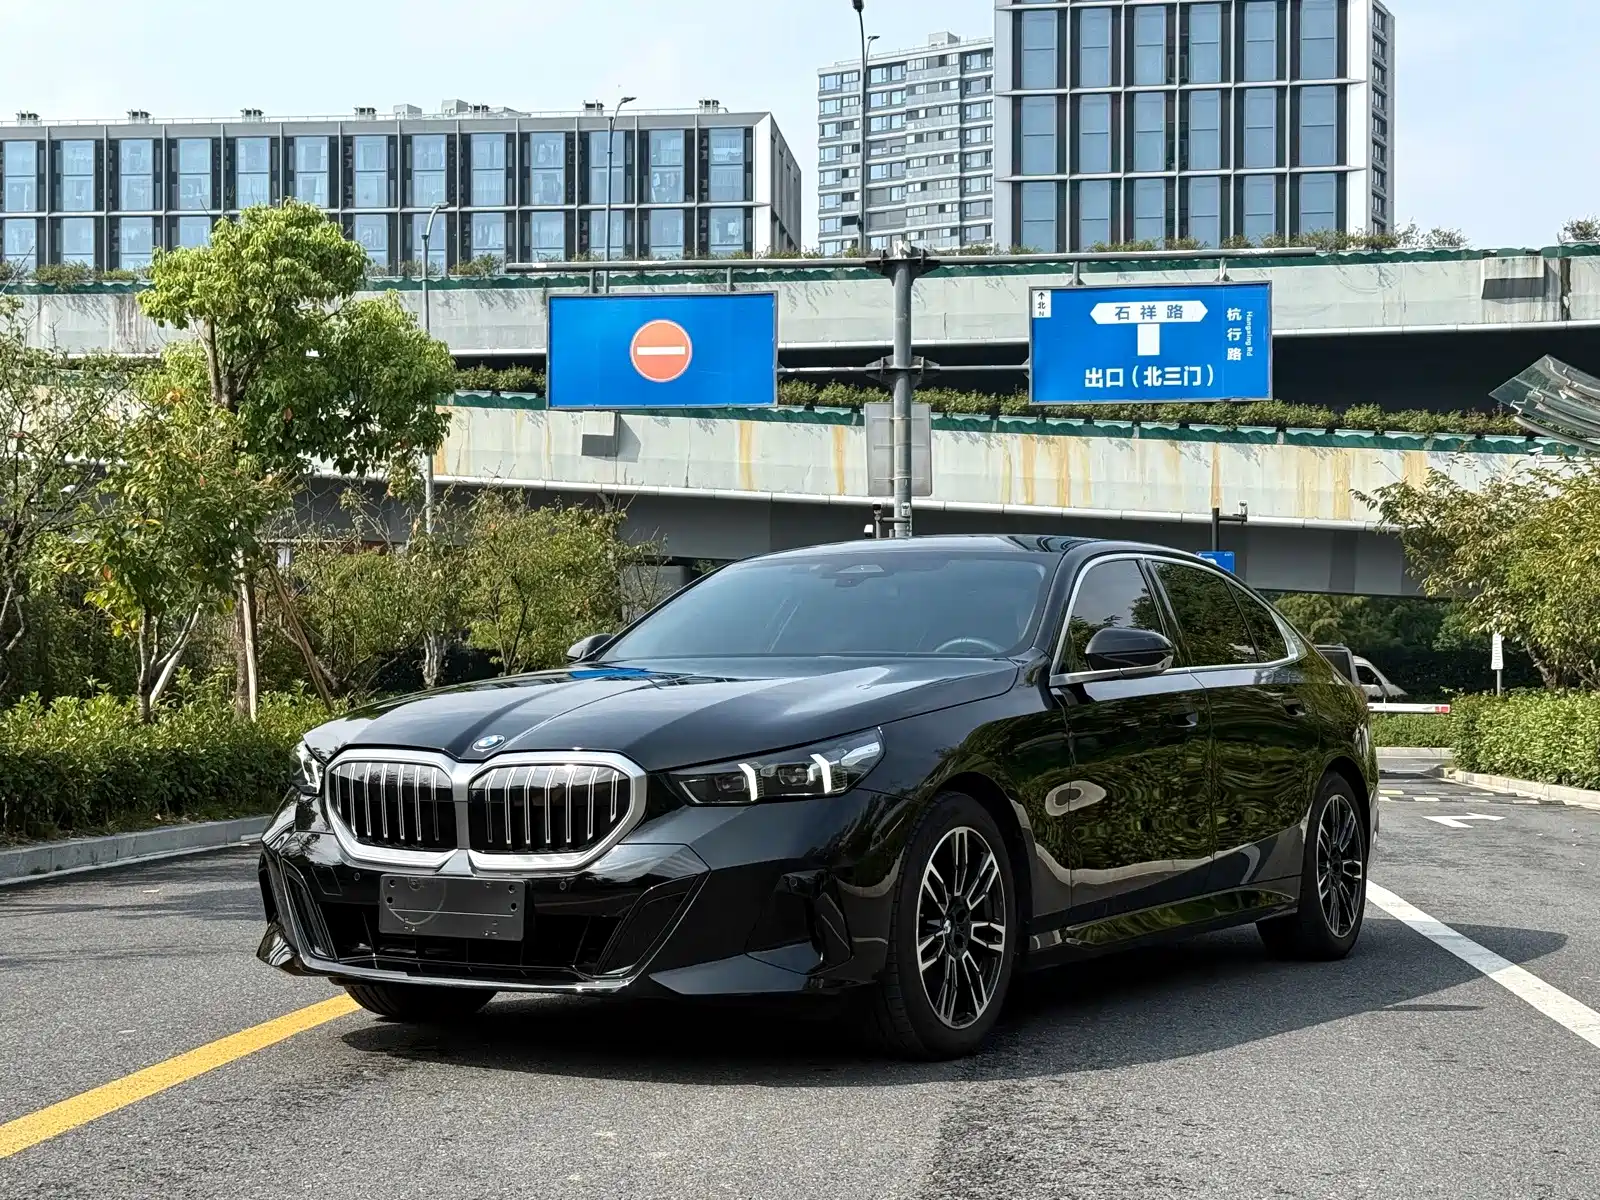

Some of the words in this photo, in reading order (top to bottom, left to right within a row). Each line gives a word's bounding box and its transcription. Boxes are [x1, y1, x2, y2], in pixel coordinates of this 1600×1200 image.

[1037, 301, 1046, 310] 北
[1114, 304, 1184, 321] 石祥路
[1226, 307, 1242, 361] 杭行路
[1246, 346, 1253, 357] Rd
